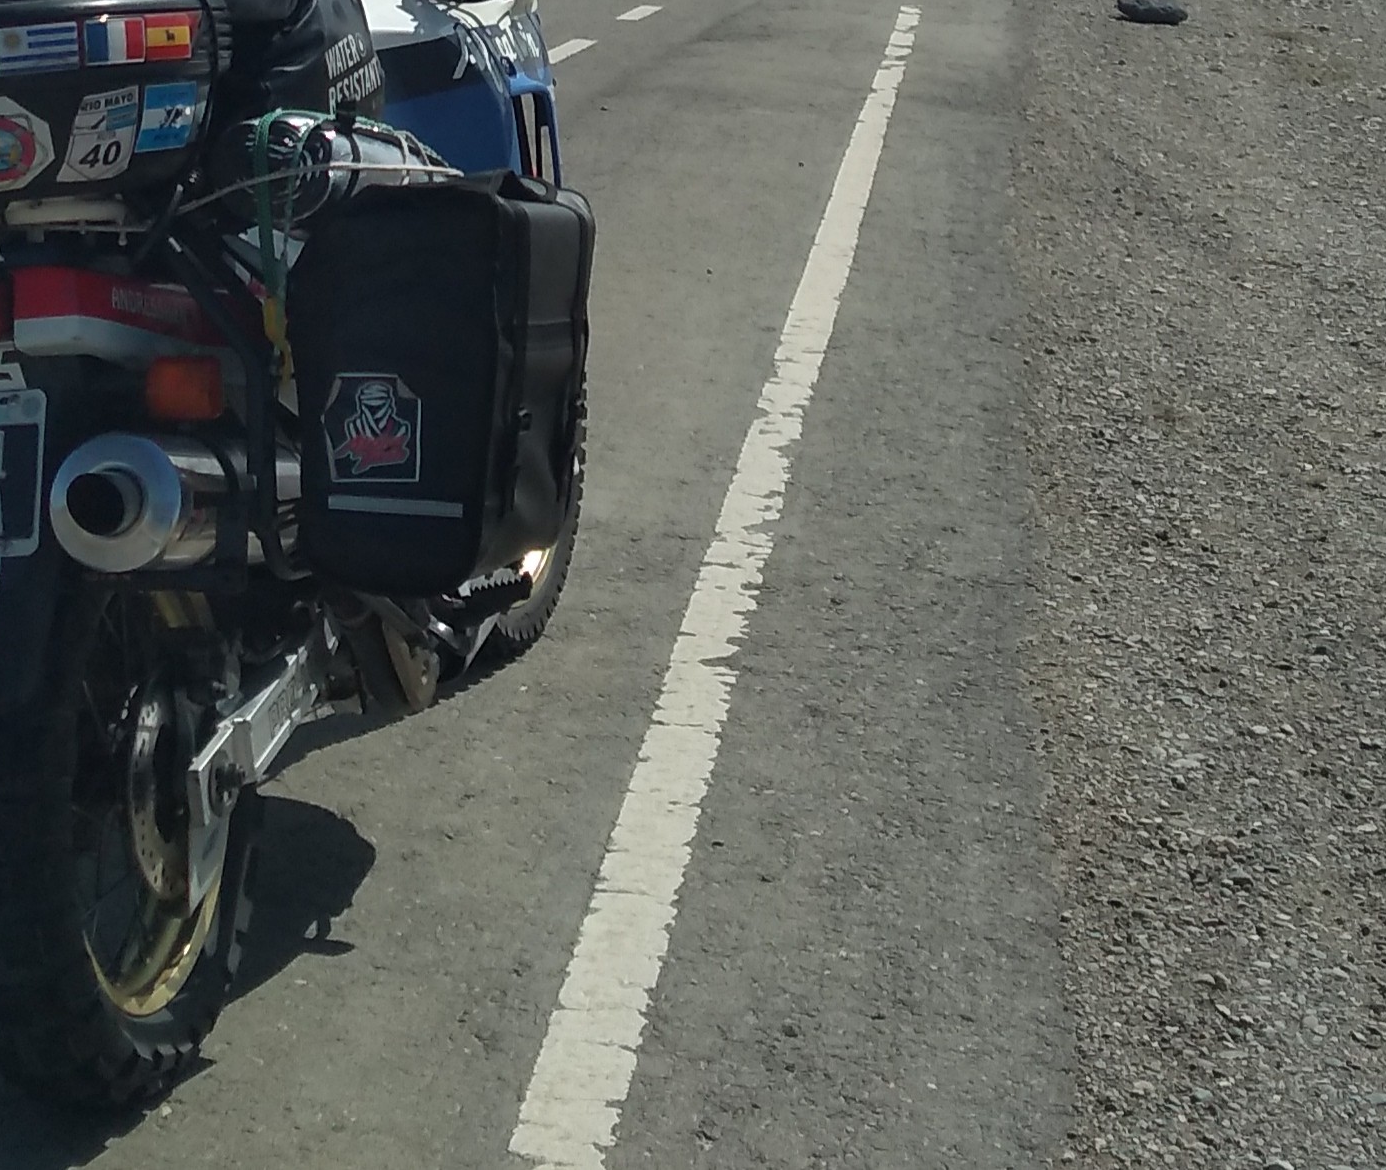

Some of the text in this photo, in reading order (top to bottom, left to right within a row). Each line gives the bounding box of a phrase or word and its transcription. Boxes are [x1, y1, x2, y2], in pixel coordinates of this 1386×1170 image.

[324, 34, 361, 80] WATER
[104, 93, 134, 108] MAYO
[328, 57, 381, 120] RESISTANT
[79, 140, 122, 168] 40
